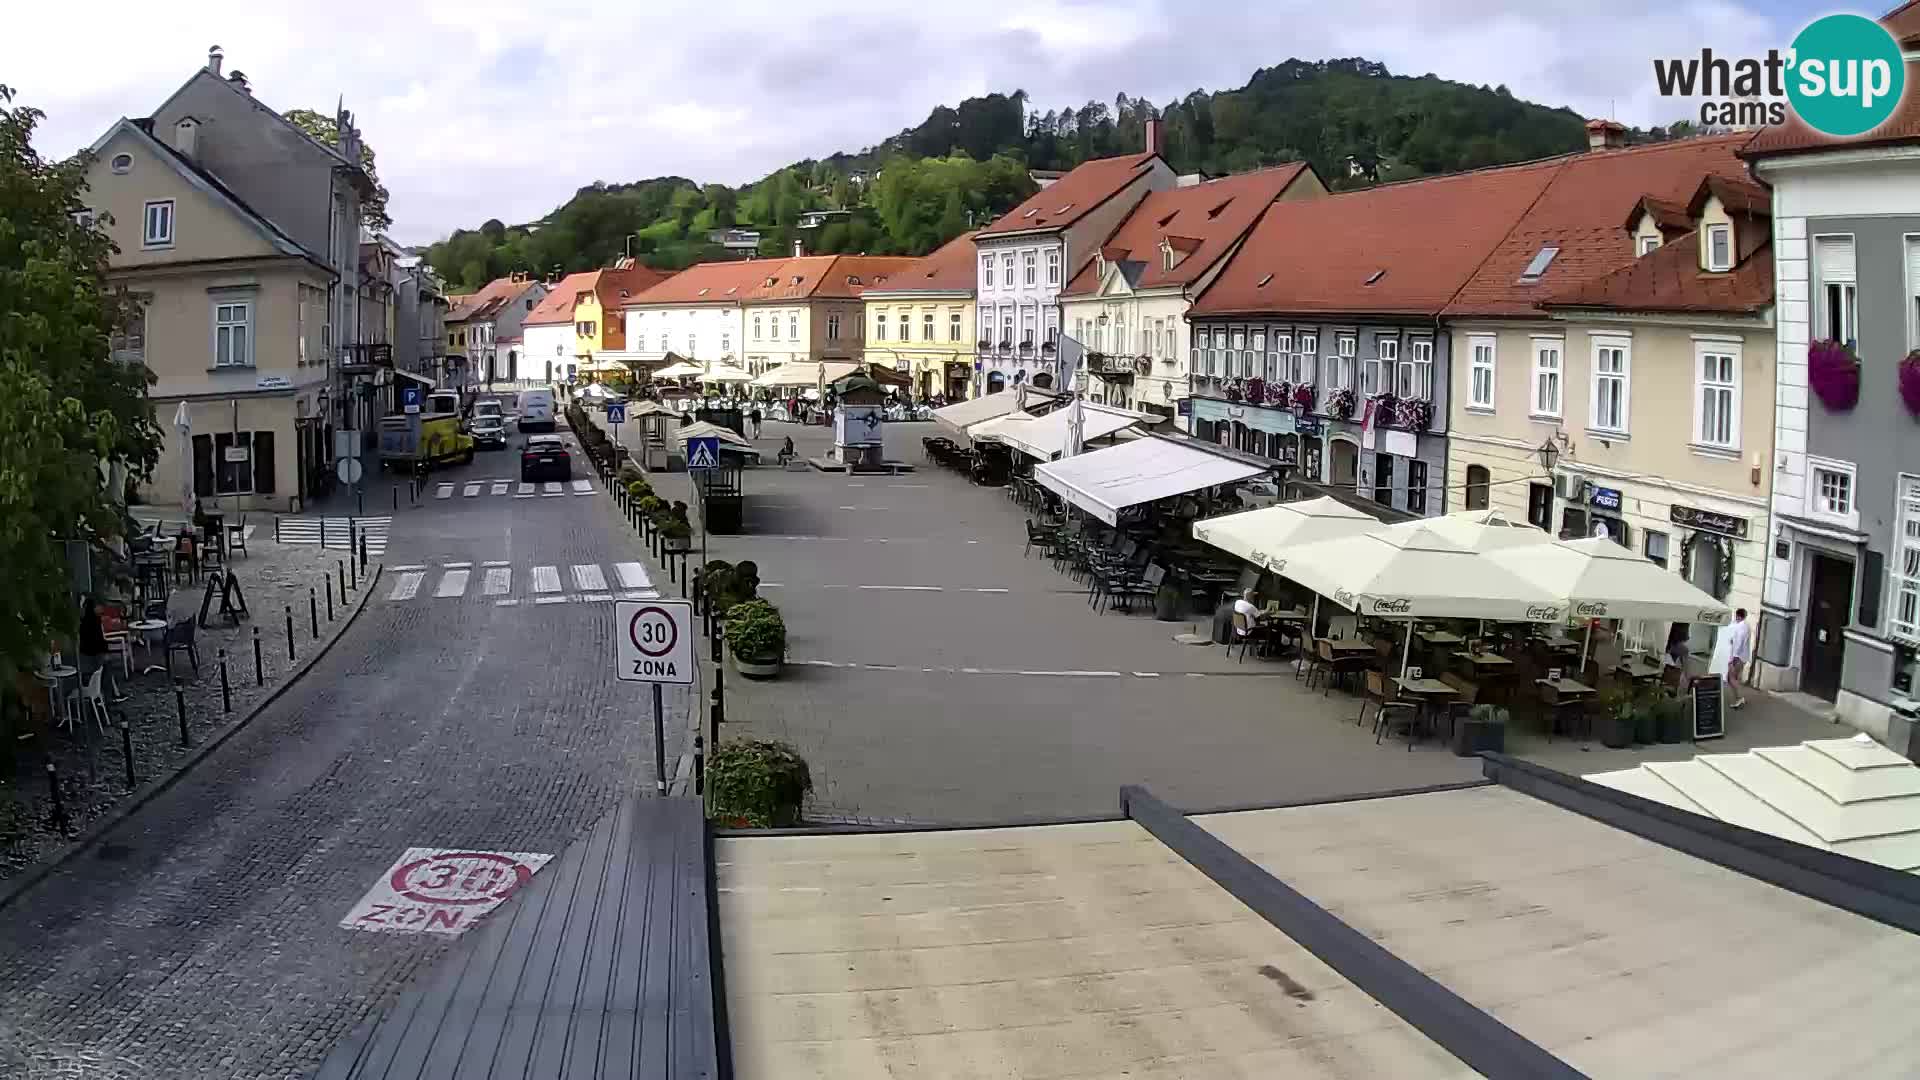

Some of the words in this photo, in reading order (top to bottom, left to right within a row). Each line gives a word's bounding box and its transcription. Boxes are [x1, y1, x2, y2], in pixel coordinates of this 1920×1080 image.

[408, 391, 416, 403] P
[642, 622, 666, 644] 30
[633, 659, 677, 677] ZONA
[419, 864, 504, 893] 30
